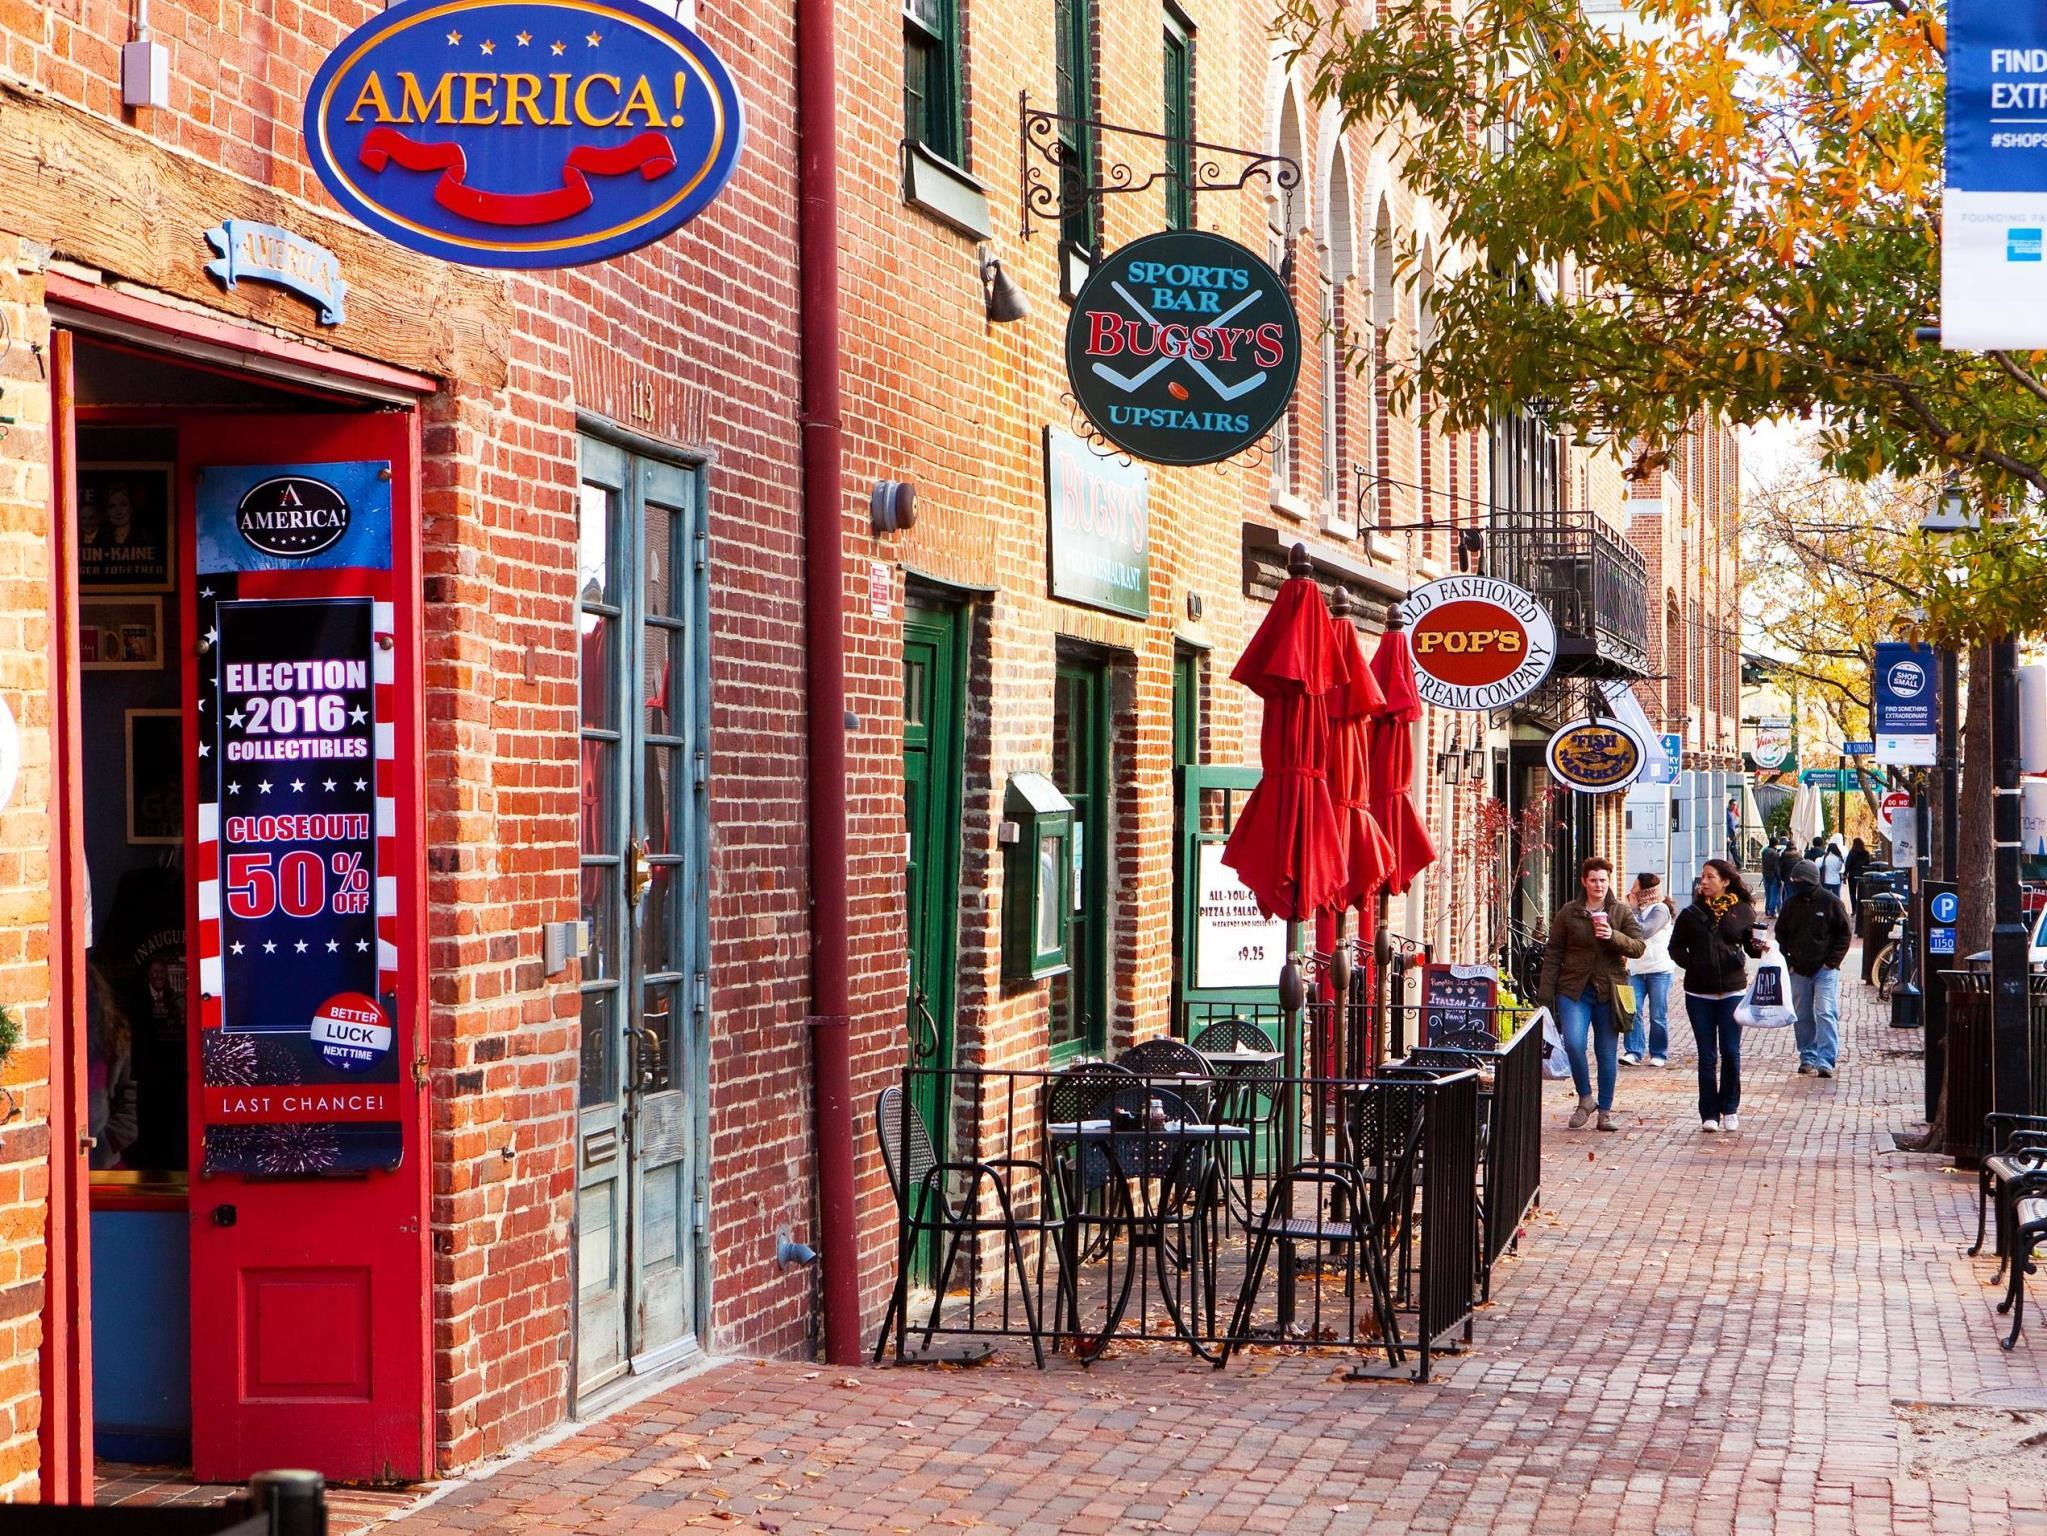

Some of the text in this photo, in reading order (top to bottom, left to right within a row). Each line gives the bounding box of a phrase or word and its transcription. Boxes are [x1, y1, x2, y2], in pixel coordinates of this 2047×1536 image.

[1990, 48, 2047, 73] FIND
[345, 71, 685, 128] AMERICA!
[241, 232, 333, 297] AMERICA
[1128, 261, 1249, 291] SPORTS
[1151, 286, 1222, 313] BAR
[1085, 311, 1284, 368] BUGSY'S
[631, 379, 653, 422] 113
[1108, 405, 1249, 433] UPSTAIRS
[240, 508, 347, 531] AMERICA!
[1438, 579, 1538, 624] FASHIONED
[1417, 630, 1521, 653] POP'S
[226, 661, 367, 692] ELECTION
[1414, 640, 1551, 708] CREAM COMPANY
[1893, 678, 1918, 688] SMALL
[1896, 671, 1918, 680] SHOP
[245, 694, 346, 734] 2016
[227, 738, 368, 760] COLLECTIBLES
[1846, 744, 1873, 753] N UNION
[226, 813, 369, 842] CLOSEOUT!
[332, 891, 369, 915] OFF
[1199, 907, 1224, 917] PIZZA
[1233, 907, 1258, 917] SALAD
[1934, 938, 1954, 948] 1150
[1756, 972, 1776, 995] GAP
[330, 1006, 378, 1024] BETTER
[326, 1024, 375, 1044] LUCK
[323, 1045, 373, 1061] NEXT TIME
[223, 1095, 385, 1112] LAST CHANCE!
